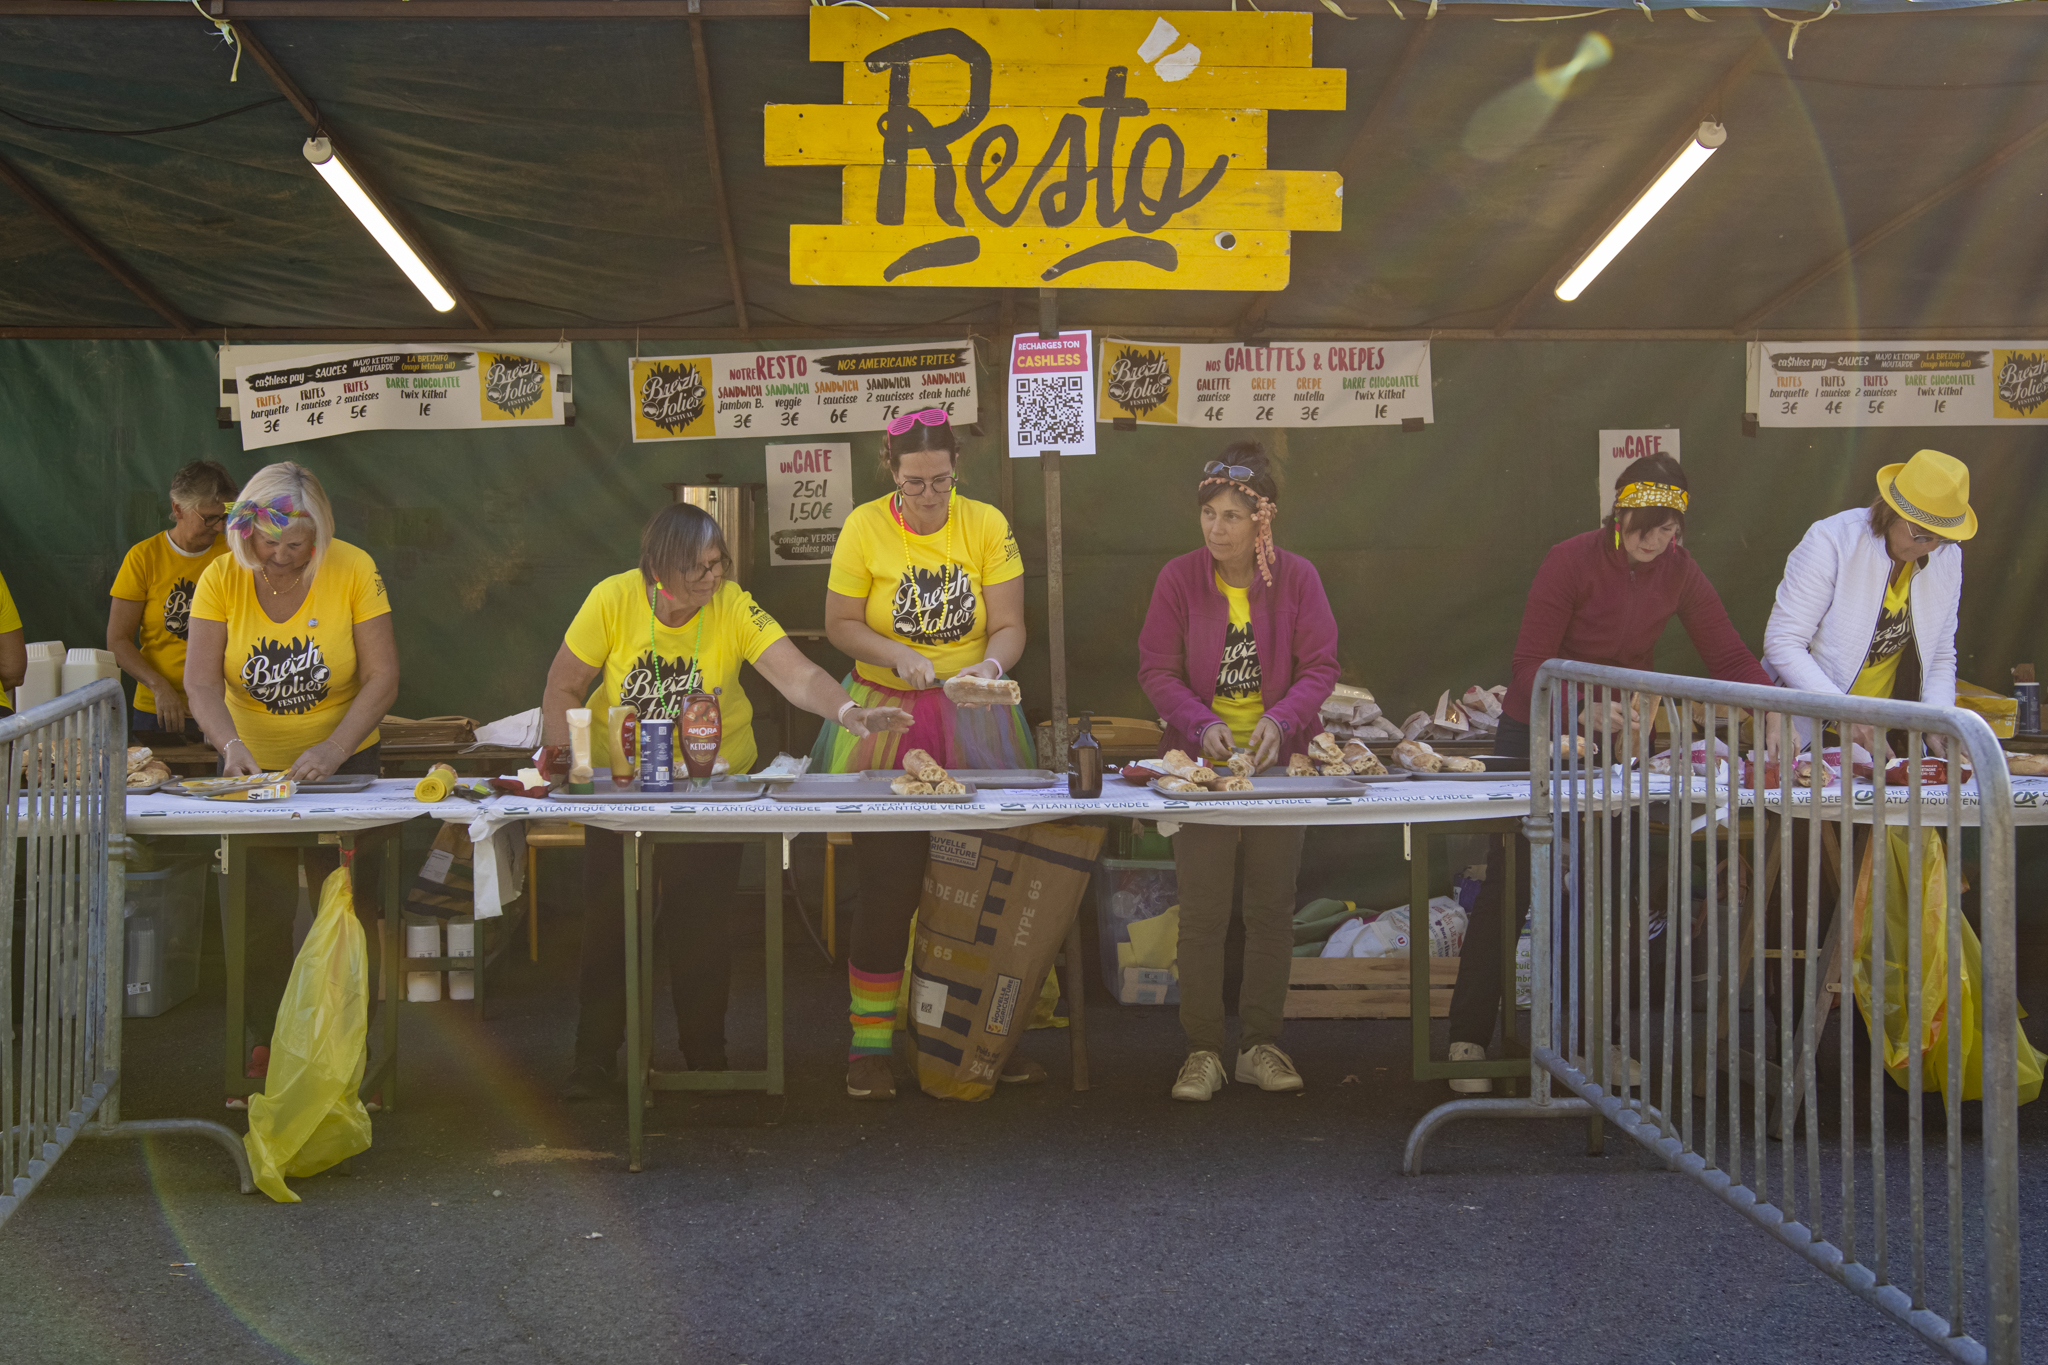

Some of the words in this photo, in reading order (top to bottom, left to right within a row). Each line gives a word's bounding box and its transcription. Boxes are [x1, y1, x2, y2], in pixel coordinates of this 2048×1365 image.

[865, 27, 1229, 234] Resto
[1018, 341, 1062, 351] RECHARGES
[1063, 340, 1080, 348] TON
[353, 357, 370, 367] MAYO
[372, 355, 401, 364] KETCHUP
[407, 355, 416, 363] LA
[837, 359, 856, 371] NOS
[858, 355, 917, 369] AMERICAINS
[920, 353, 956, 366] FRITES
[1017, 353, 1081, 368] CASHLESS
[1206, 360, 1221, 372] NOS
[1224, 347, 1306, 372] GALETTES
[1313, 352, 1323, 371] &
[1328, 346, 1385, 372] CREPES
[1812, 358, 1827, 369] pay
[1837, 356, 1870, 367] SAUCES
[1874, 353, 1892, 361] MAYO
[1893, 353, 1920, 361] KETCHUP
[1926, 352, 1935, 360] LA
[360, 363, 394, 373] MOUTARDE
[729, 367, 756, 380] NOTRE
[756, 354, 808, 381] RESTO
[1108, 355, 1167, 383] Breizh
[1881, 360, 1913, 368] MOUTARDE
[289, 373, 305, 384] pay
[315, 364, 348, 378] SAUCES
[485, 360, 540, 387] Breizh
[921, 372, 966, 386] SANDWICH
[1905, 374, 1927, 386] BARRE
[343, 380, 369, 394] FRITES
[385, 376, 409, 388] BARRE
[641, 367, 700, 403] Breizh
[814, 380, 859, 394] SANDWICH
[866, 376, 911, 391] SANDWICH
[1197, 377, 1231, 391] GALETTE
[1251, 377, 1277, 390] CREPE
[1296, 377, 1322, 390] CREPE
[1342, 376, 1366, 390] BARRE
[1777, 376, 1802, 387] FRITES
[1821, 376, 1845, 387] FRITES
[1863, 375, 1888, 387] FRITES
[300, 387, 325, 401] FRITES
[401, 389, 419, 399] twix
[717, 385, 763, 399] SANDWICH
[765, 383, 810, 396] SANDWICH
[919, 388, 942, 400] steak
[944, 386, 971, 399] haché
[1253, 392, 1276, 401] sucre
[1294, 391, 1325, 401] nutella
[1355, 390, 1375, 401] twix
[1770, 388, 1809, 399] barquette
[1820, 388, 1851, 397] saucisse
[1855, 388, 1861, 397] 2
[1863, 388, 1898, 397] saucisses
[1918, 387, 1936, 396] twix
[256, 394, 282, 408] FRITES
[336, 396, 342, 404] 2
[344, 392, 379, 404] saucisses
[507, 396, 534, 407] FESTIVAL
[775, 398, 802, 410] veggie
[823, 394, 858, 405] saucisse
[866, 393, 873, 402] 2
[875, 392, 914, 402] saucisses
[1129, 398, 1158, 406] FESTIVAL
[1197, 393, 1231, 402] saucisse
[301, 399, 332, 410] saucisse
[419, 402, 431, 416] 1€
[717, 400, 751, 414] jambon
[755, 398, 764, 409] B.
[1374, 404, 1388, 419] 1€
[1781, 401, 1798, 414] 3€
[1825, 400, 1843, 414] 4€
[1868, 400, 1885, 414] 5€
[1934, 400, 1946, 413] 1€
[251, 405, 289, 419] barquette
[307, 411, 324, 426] 4€
[350, 405, 367, 419] 5€
[665, 412, 694, 423] FESTIVAL
[781, 412, 799, 426] 3€
[830, 409, 848, 424] 6€
[882, 405, 900, 421] 7€
[1204, 406, 1224, 421] 4€
[1255, 407, 1274, 421] 2€
[1300, 406, 1320, 421] 3€
[263, 419, 280, 433] 3€
[733, 414, 752, 428] 3€
[1612, 447, 1625, 458] UN
[780, 461, 793, 473] UN
[793, 449, 833, 474] CAFE
[792, 479, 828, 498] 25cl
[789, 501, 833, 523] 1,50€
[778, 534, 809, 546] consigne
[811, 533, 837, 543] VERRE
[791, 545, 819, 554] cashless
[892, 569, 969, 616] Breizh
[241, 641, 323, 689] Breizh
[620, 667, 704, 701] Breizh
[277, 693, 317, 708] FESTIVAL
[687, 727, 718, 736] AMORA
[689, 743, 717, 751] KETCHUP
[930, 835, 967, 849] OUVELLE
[931, 843, 977, 859] RICULTURE
[935, 883, 952, 901] DE
[954, 889, 979, 909] BLÉ
[1014, 906, 1036, 948] TYPE
[1028, 880, 1042, 900] 65
[933, 945, 952, 961] 65
[994, 987, 1007, 1024] NOUVELLE
[999, 979, 1013, 1025] AGRICULTURE
[969, 1060, 982, 1075] 25
[983, 1064, 995, 1080] kg
